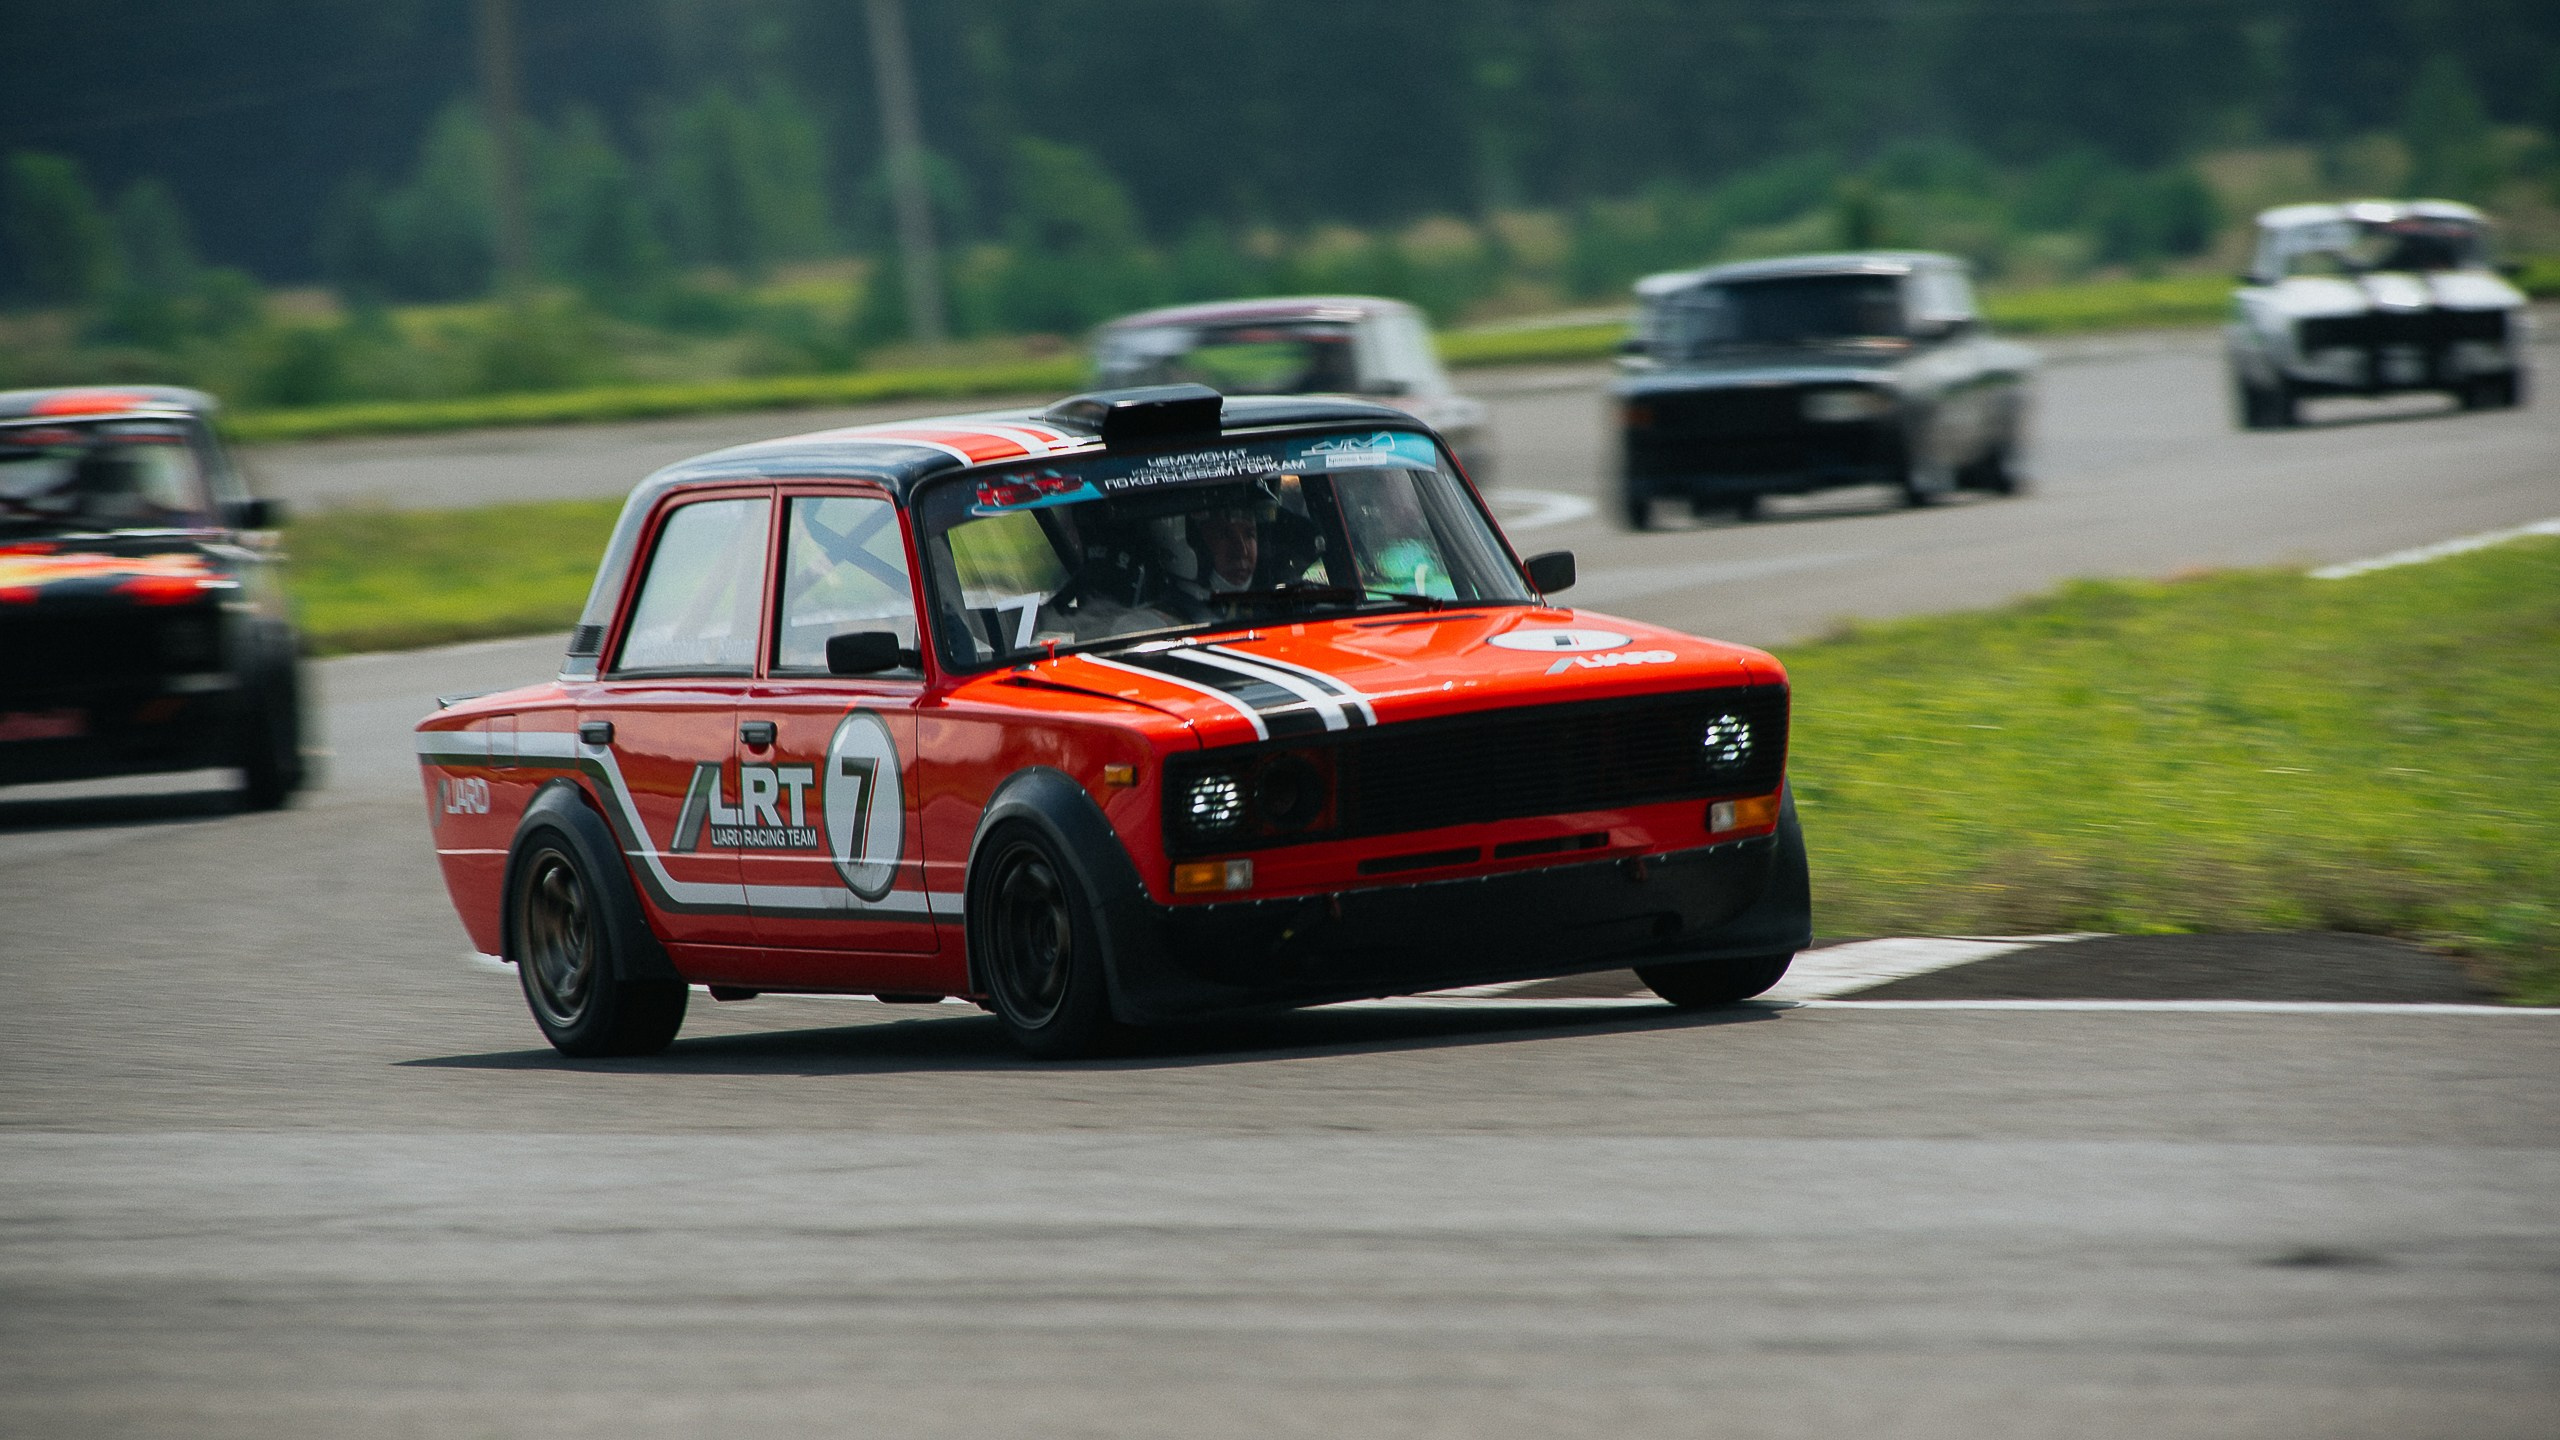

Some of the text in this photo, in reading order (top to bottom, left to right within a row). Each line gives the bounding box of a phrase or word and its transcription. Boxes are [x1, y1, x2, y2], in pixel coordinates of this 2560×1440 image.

[1104, 477, 1129, 490] ПО
[1129, 466, 1235, 487] КОЛЬЦЕВЫМ
[1236, 458, 1307, 476] ГОНКАМ
[996, 591, 1041, 650] 7
[708, 767, 814, 827] LRT
[841, 757, 880, 866] 7
[710, 828, 818, 847] LIARD RACING TEAM
